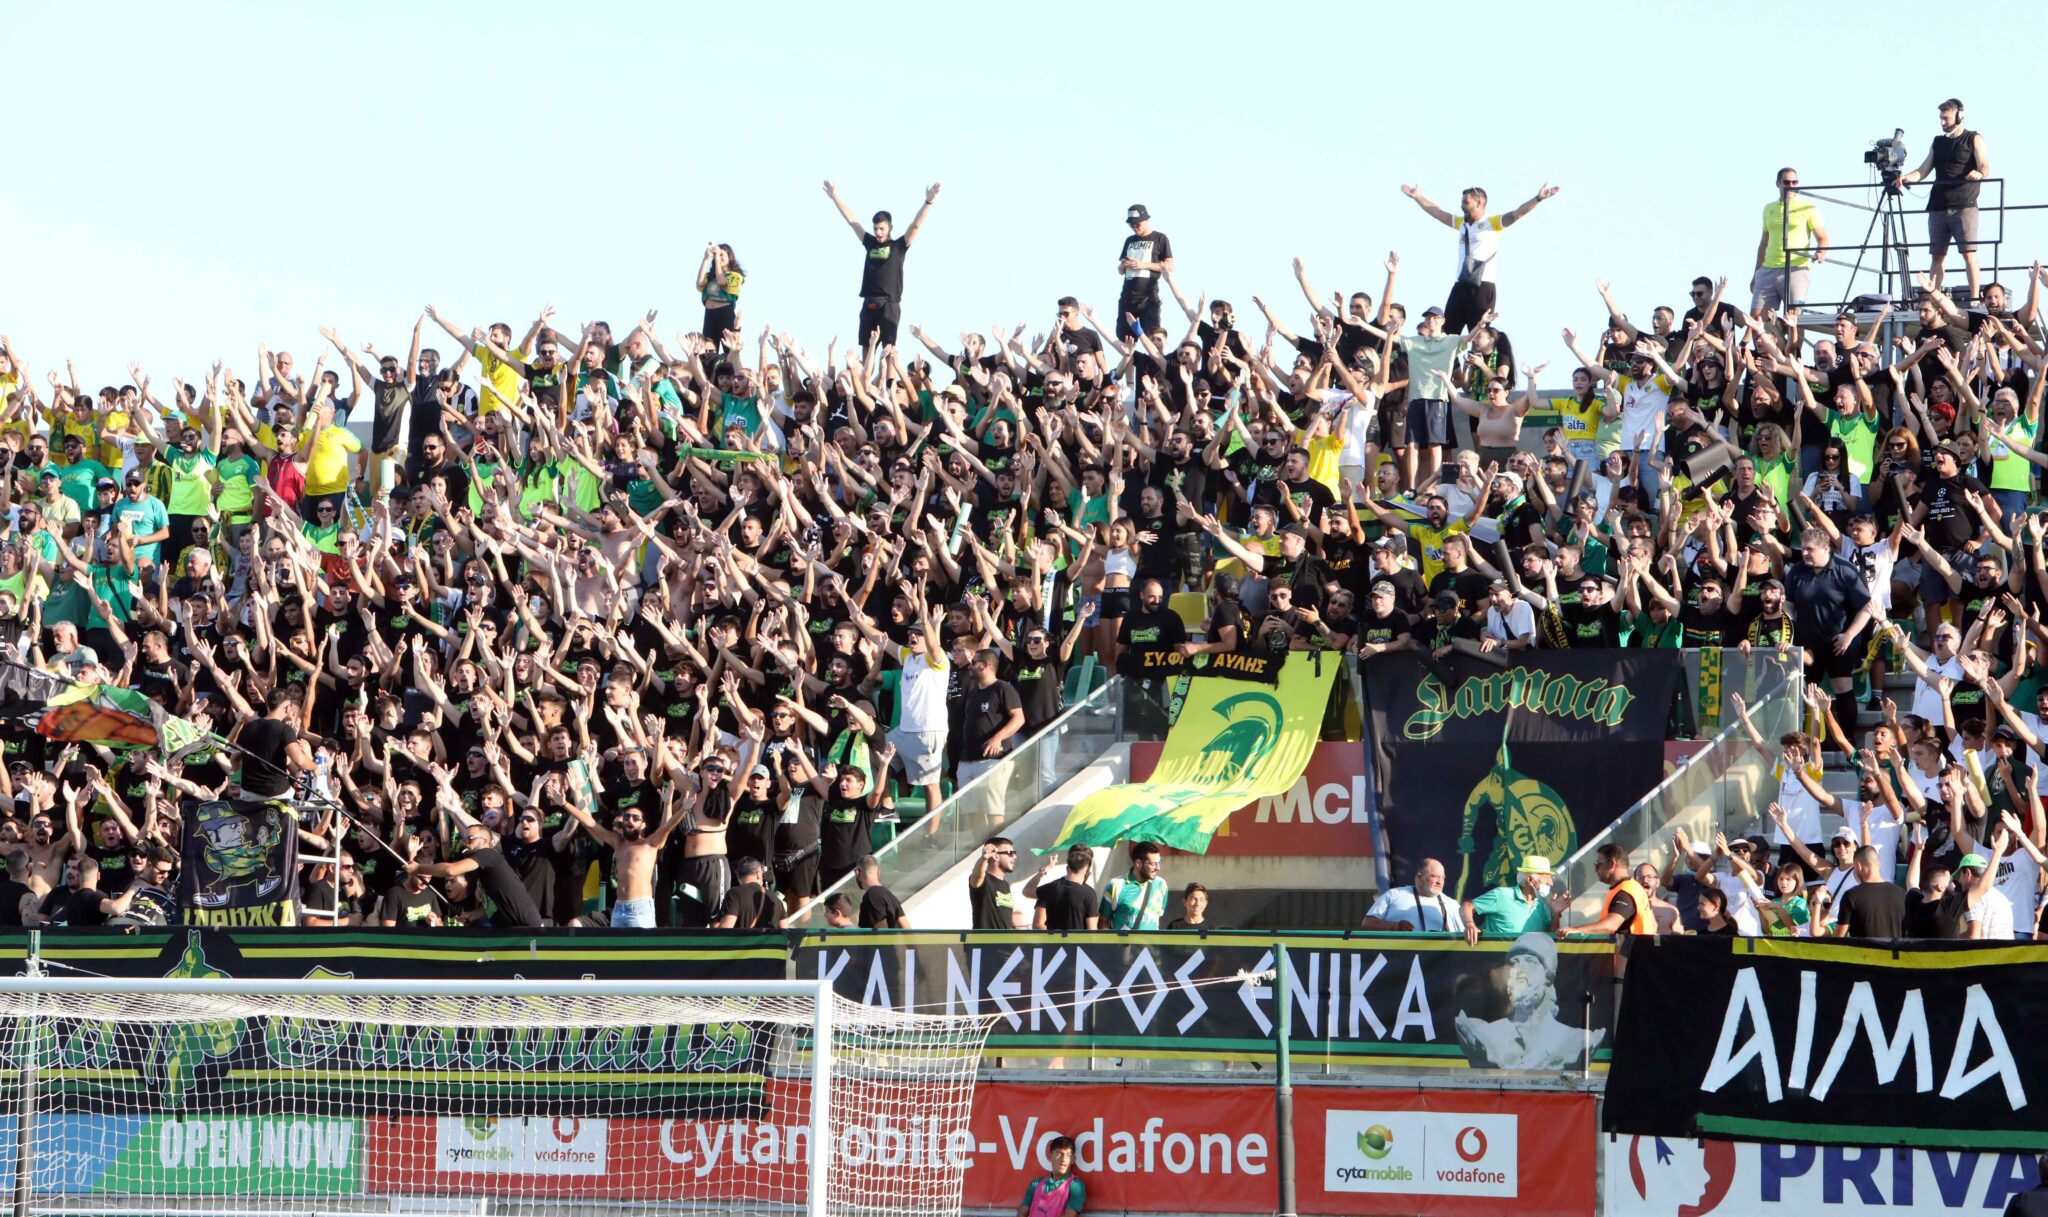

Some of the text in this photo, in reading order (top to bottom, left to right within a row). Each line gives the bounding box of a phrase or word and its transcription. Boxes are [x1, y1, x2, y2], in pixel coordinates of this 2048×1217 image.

[1567, 420, 1586, 430] alfa
[1403, 665, 1636, 740] Larnaca
[159, 1120, 352, 1169] OPEN NOW
[535, 1148, 596, 1163] vodafone
[1336, 1165, 1413, 1182] cytamobile
[1437, 1168, 1506, 1184] vodafone
